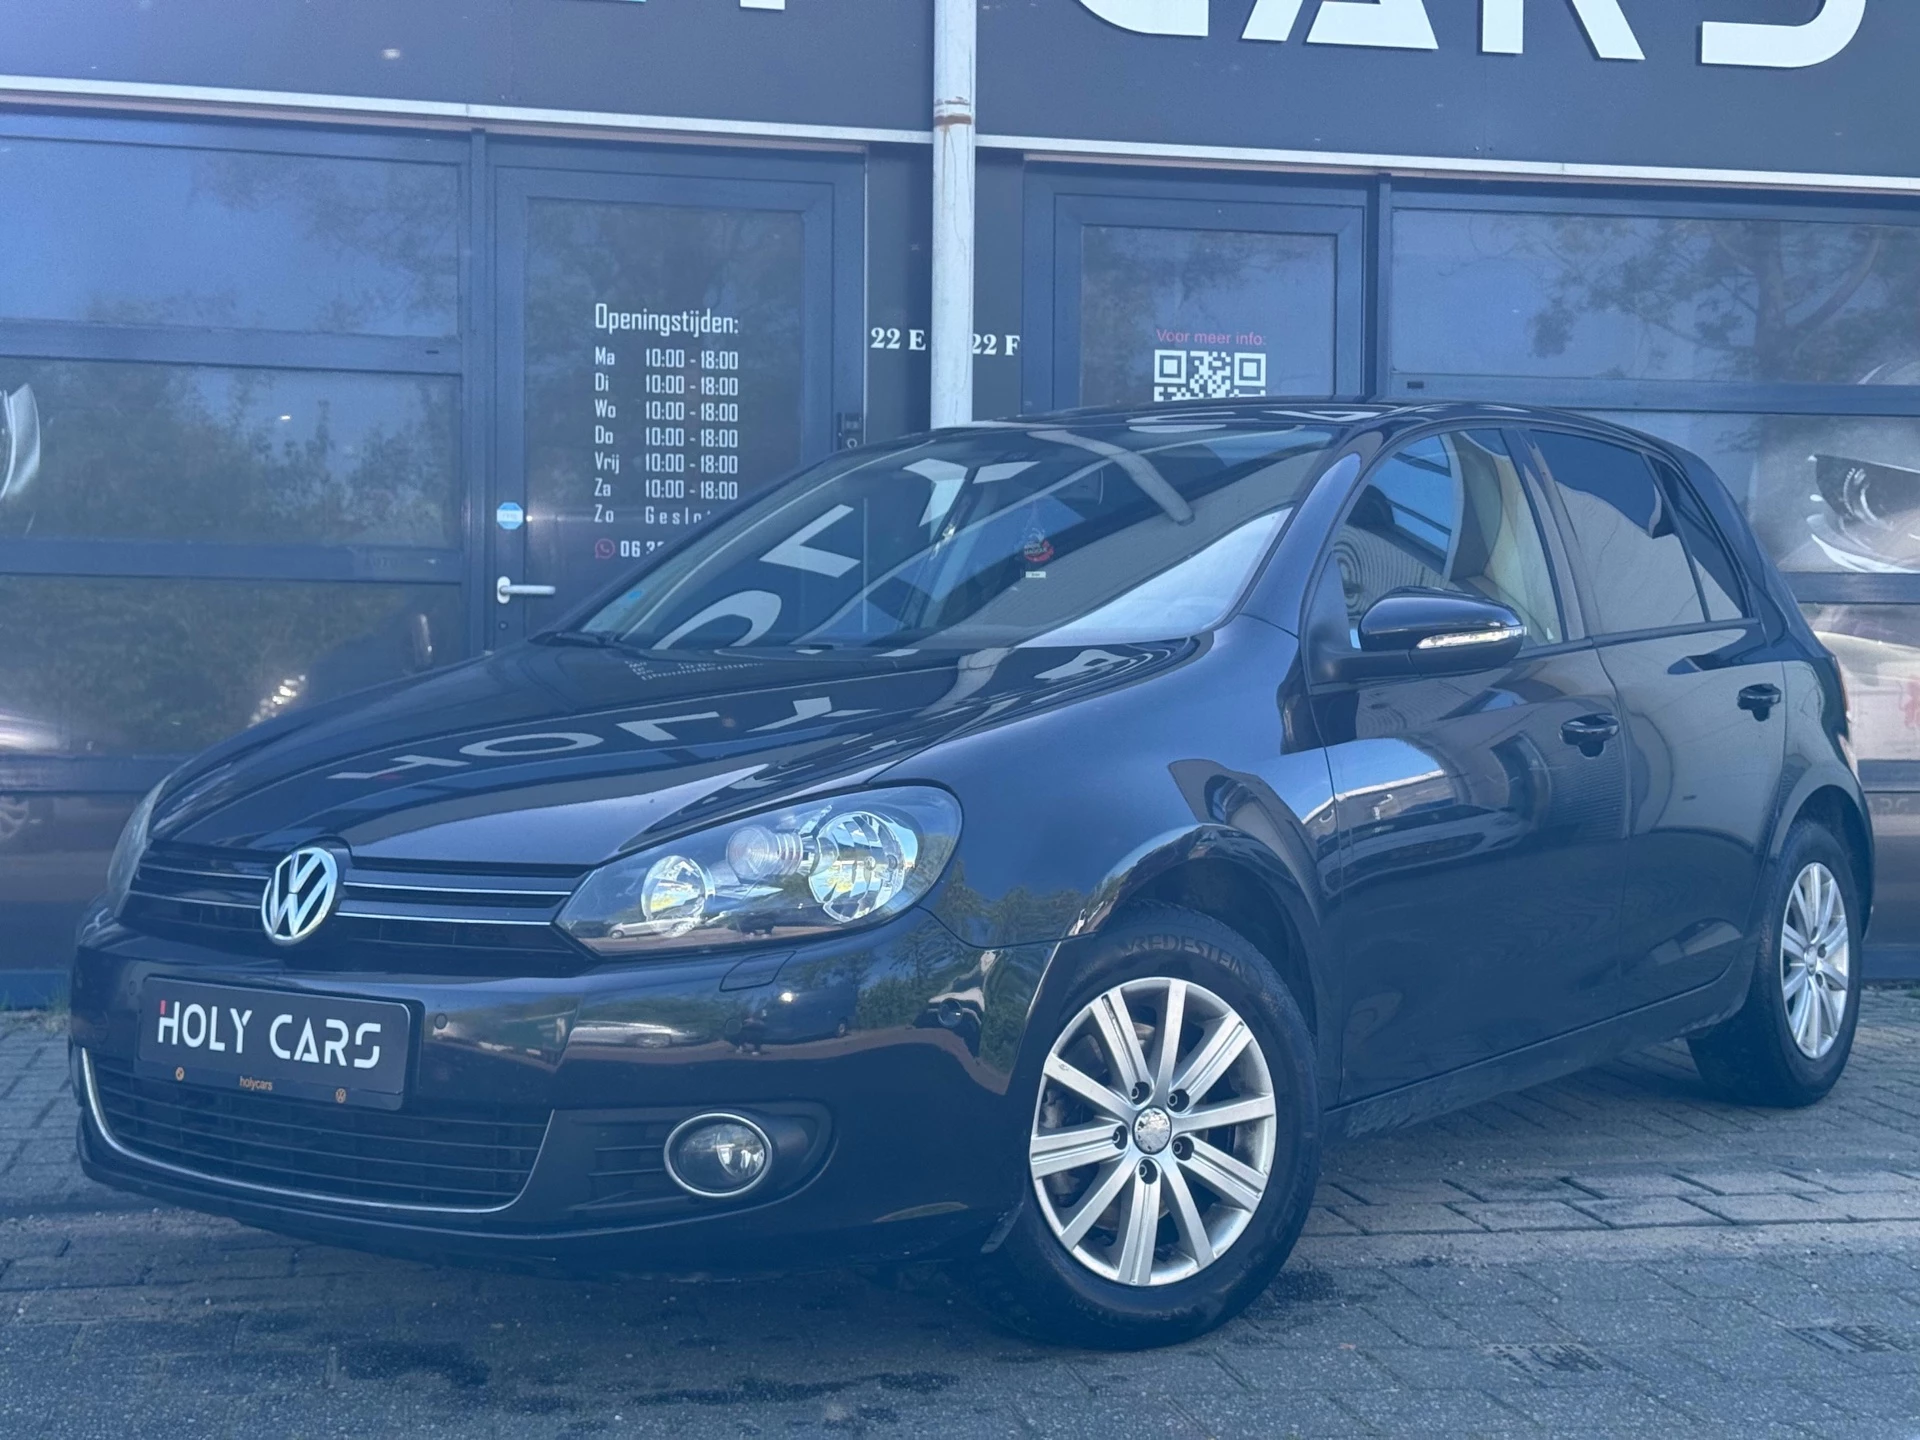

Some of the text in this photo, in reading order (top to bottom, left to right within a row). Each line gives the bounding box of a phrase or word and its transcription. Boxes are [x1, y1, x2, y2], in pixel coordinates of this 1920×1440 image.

[595, 303, 739, 338] Openingstijden:
[870, 328, 926, 351] 22 E
[973, 334, 1021, 356] 22 F
[1156, 329, 1267, 346] Voor meer info:
[595, 347, 616, 366] Ma
[645, 349, 685, 369] 10:00
[700, 351, 739, 370] 18:00
[594, 373, 609, 392] Di
[645, 375, 685, 395] 10:00
[700, 377, 739, 396] 18:00
[594, 399, 617, 419] Wo
[645, 401, 685, 421] 10:00
[700, 403, 739, 422] 18:00
[594, 425, 614, 445] Do
[645, 427, 685, 447] 10:00
[700, 429, 738, 449] 18:00
[594, 452, 620, 475] Vrij
[645, 453, 685, 473] 10:00
[700, 455, 738, 474] 18:00
[594, 478, 612, 497] Za
[645, 479, 685, 499] 10:00
[700, 481, 738, 500] 18:00
[593, 504, 615, 523] Zo
[620, 541, 641, 558] 06
[157, 1000, 382, 1069] HOLY CARS
[239, 1076, 273, 1092] holycars
